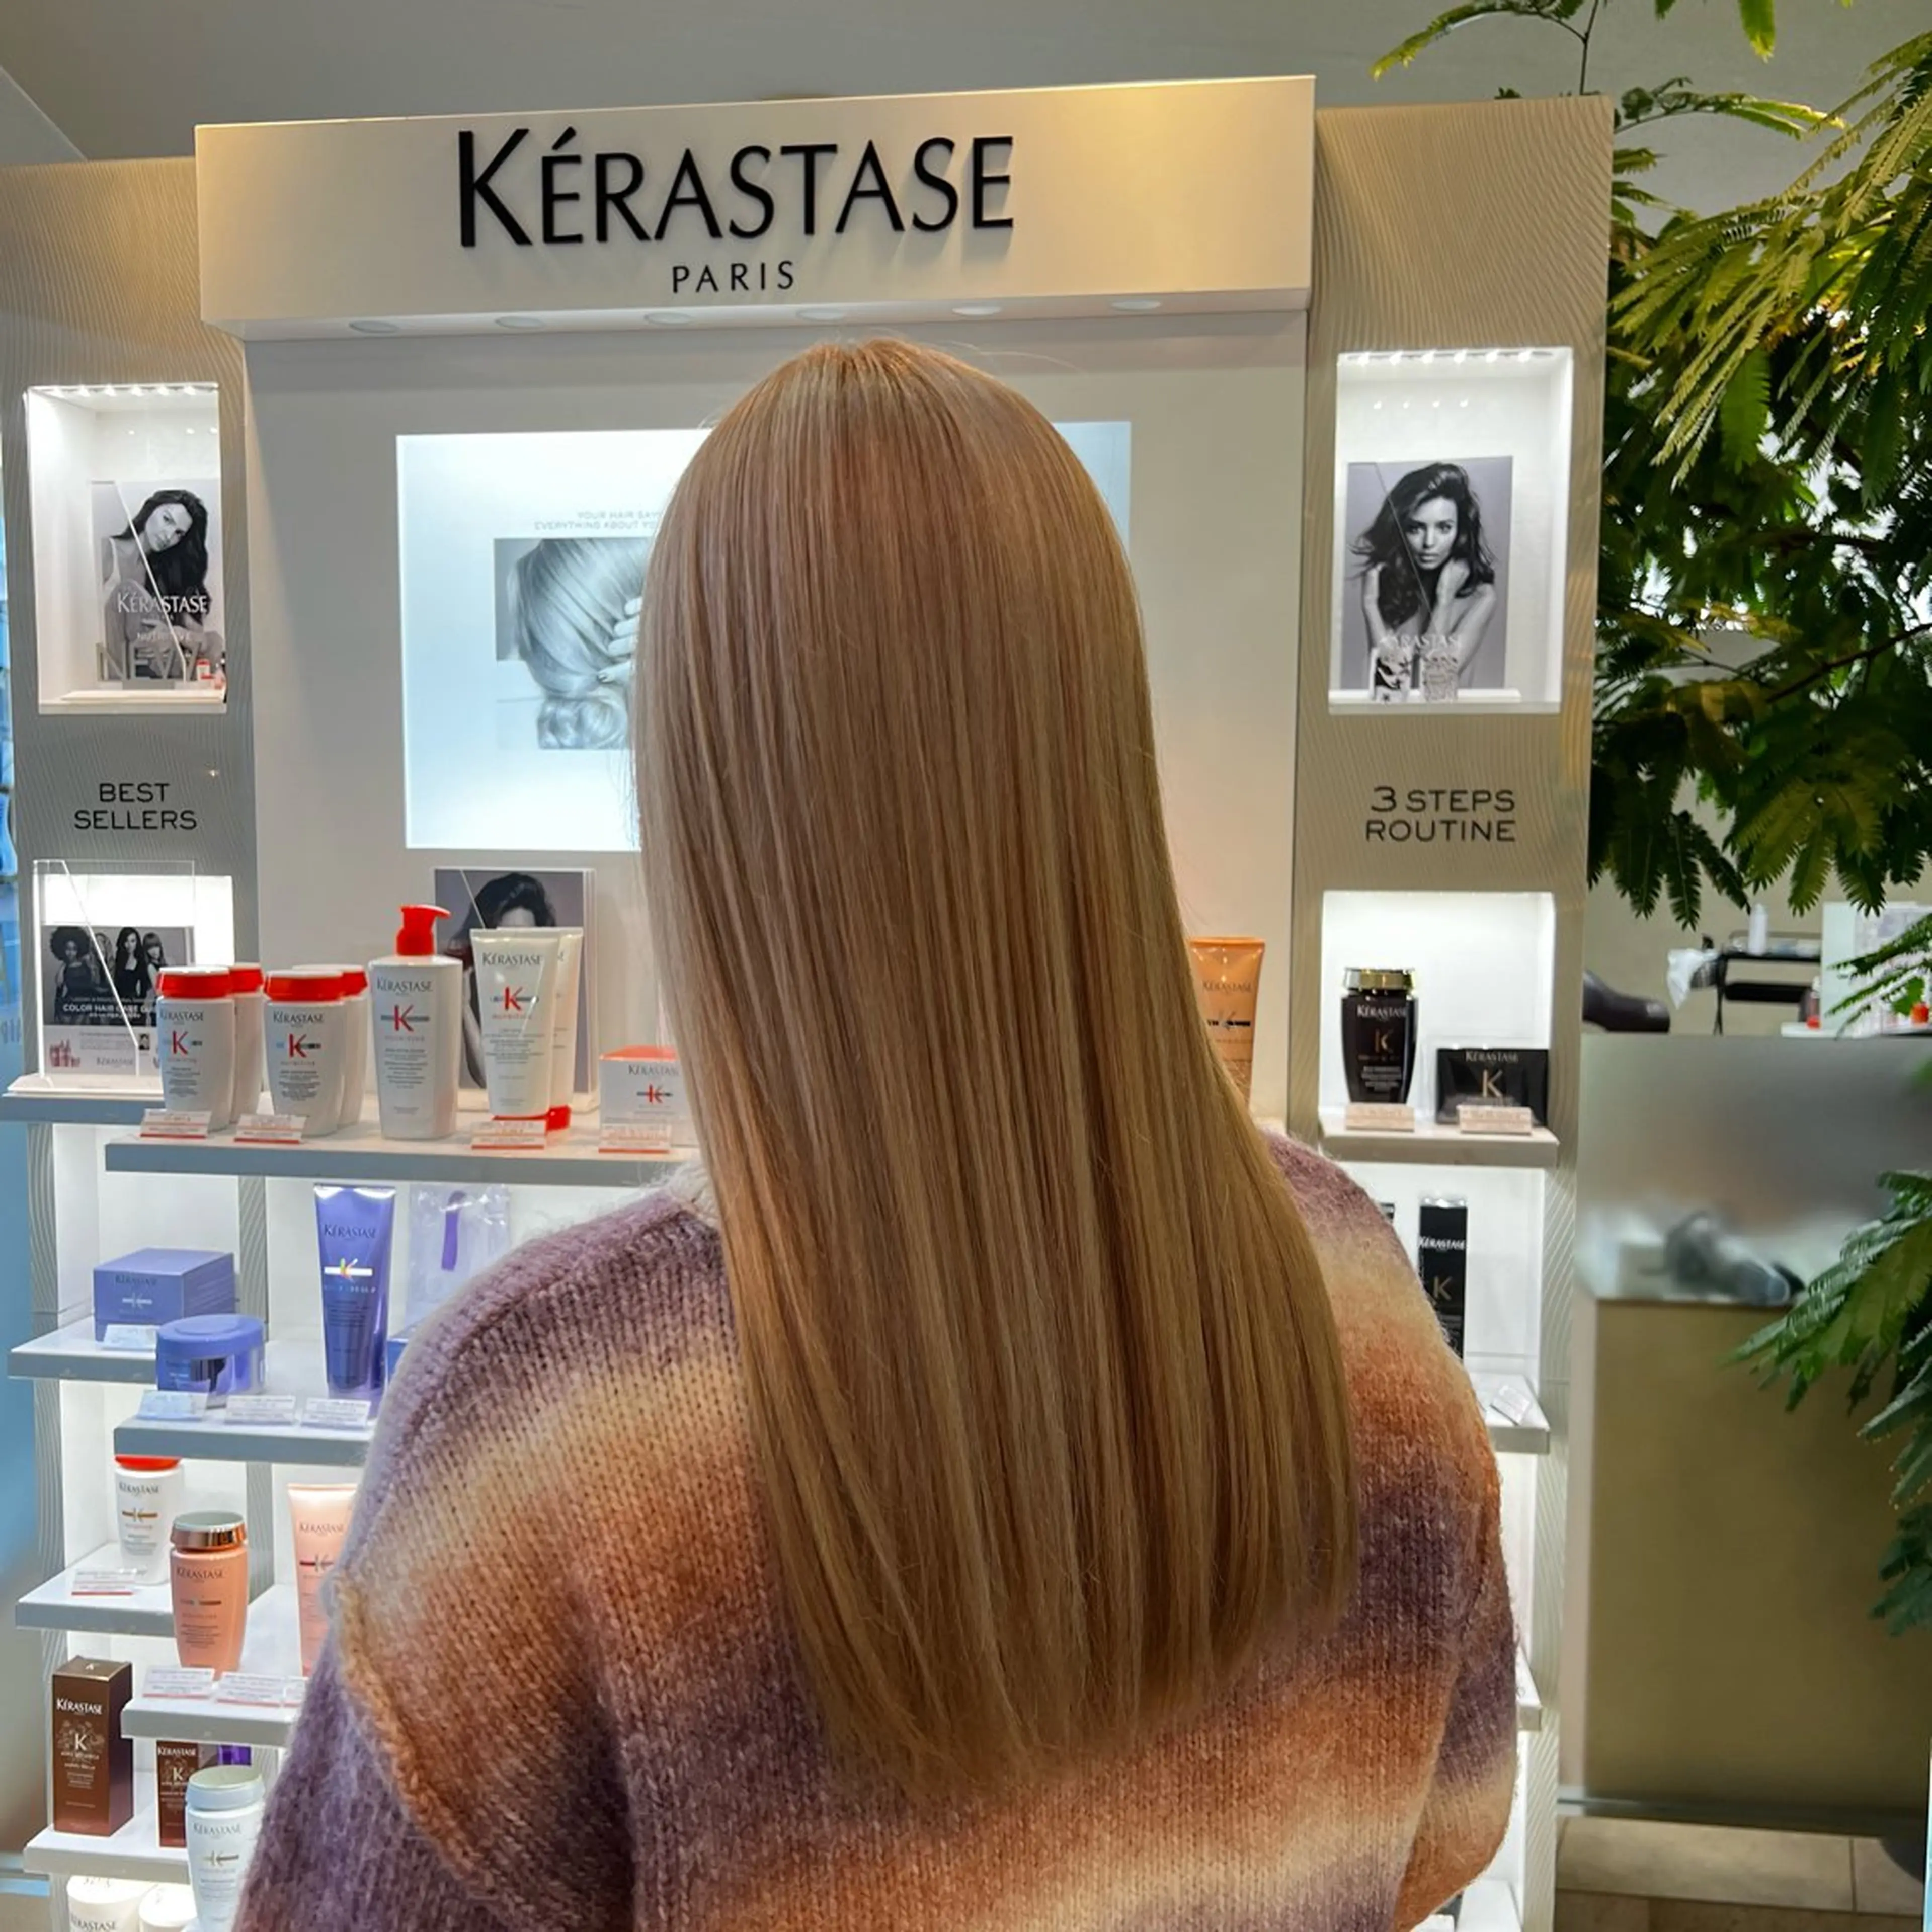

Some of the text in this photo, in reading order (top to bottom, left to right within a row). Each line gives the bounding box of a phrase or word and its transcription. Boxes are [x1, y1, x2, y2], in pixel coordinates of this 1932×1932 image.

[458, 127, 1013, 247] KÉRASTASE
[672, 261, 794, 293] PARIS
[117, 592, 208, 613] KÉRASTASE
[100, 783, 170, 802] BEST
[1371, 786, 1515, 813] 3 STEPS
[74, 809, 197, 830] SELLERS
[1365, 820, 1516, 842] ROUTINE
[505, 986, 523, 1011] K
[394, 1004, 414, 1031] K
[172, 1031, 188, 1055] K
[288, 1034, 307, 1058] K
[1483, 1069, 1503, 1097] K
[1433, 1276, 1453, 1300] K
[74, 1733, 87, 1751] K
[173, 1767, 184, 1781] K
